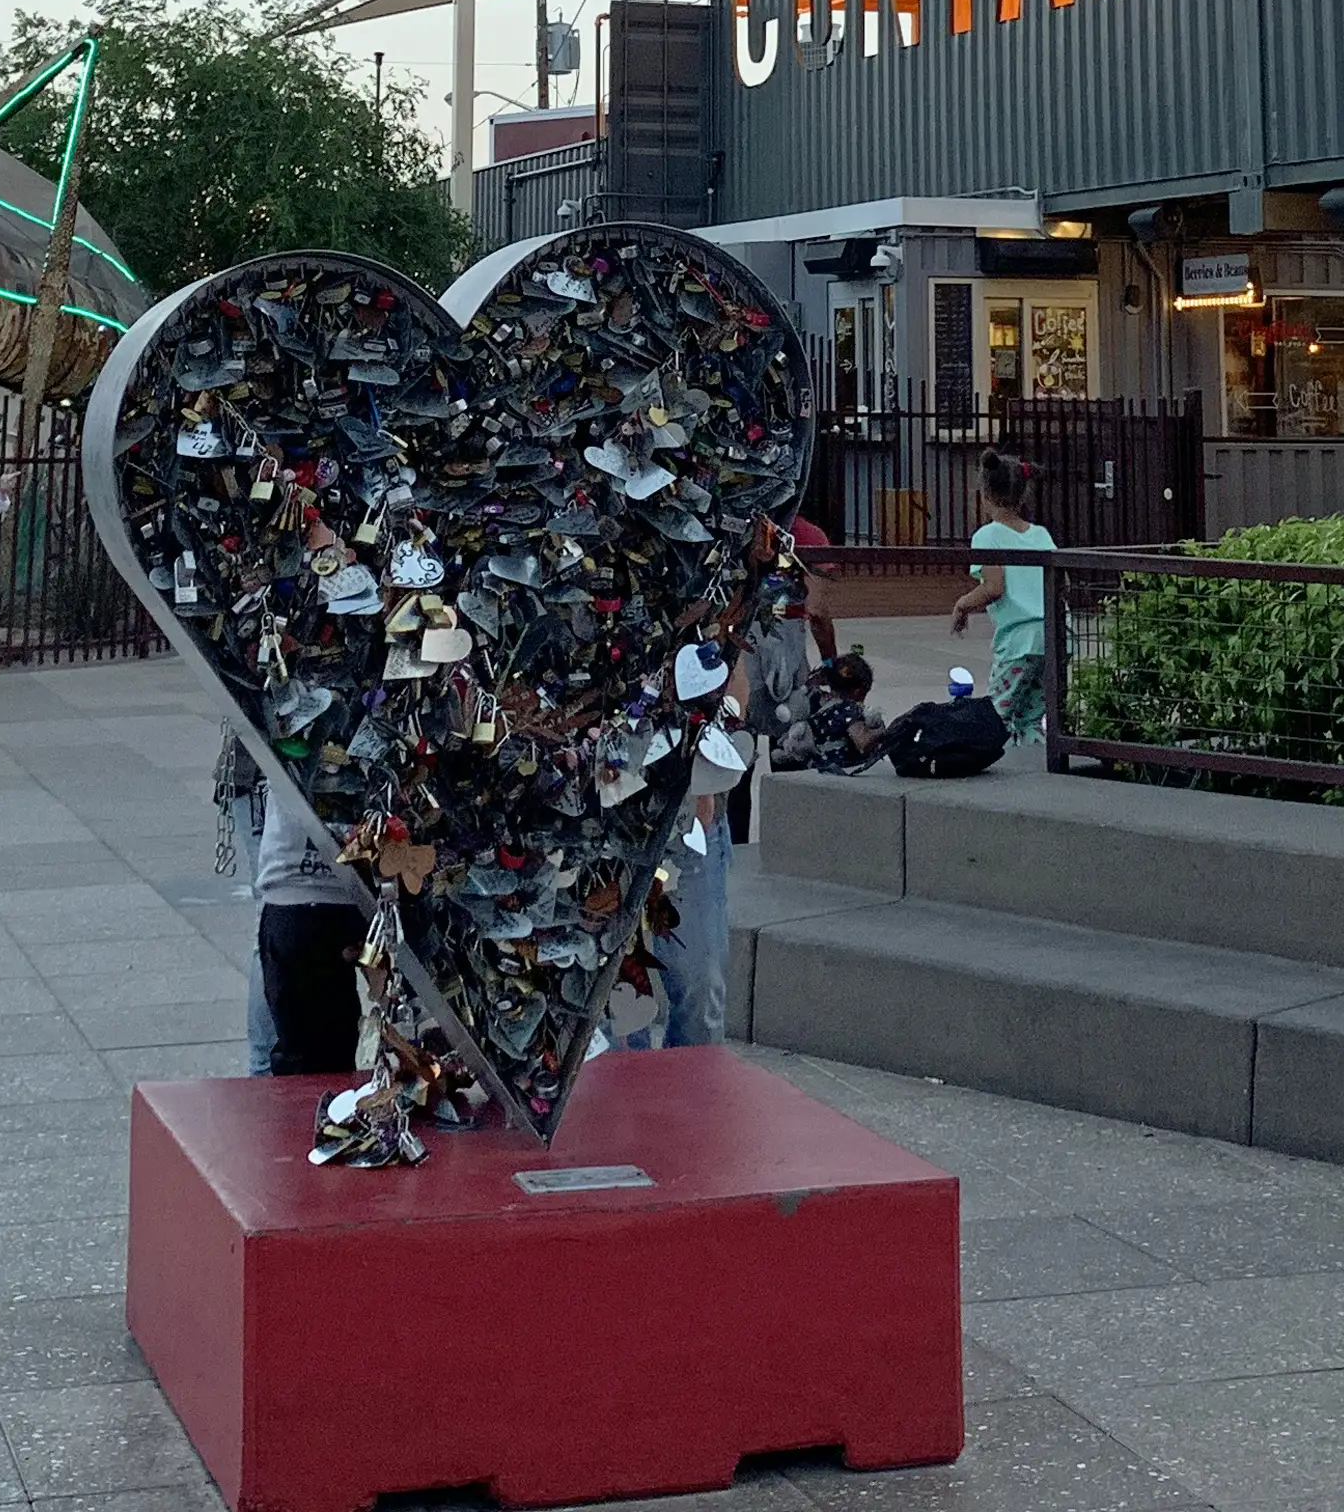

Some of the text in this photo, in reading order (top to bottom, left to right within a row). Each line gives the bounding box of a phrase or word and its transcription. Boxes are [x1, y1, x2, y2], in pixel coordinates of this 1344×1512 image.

[1184, 264, 1213, 280] Berries
[1216, 263, 1223, 278] &
[1035, 308, 1085, 339] Coffee
[1289, 380, 1337, 413] Coffee
